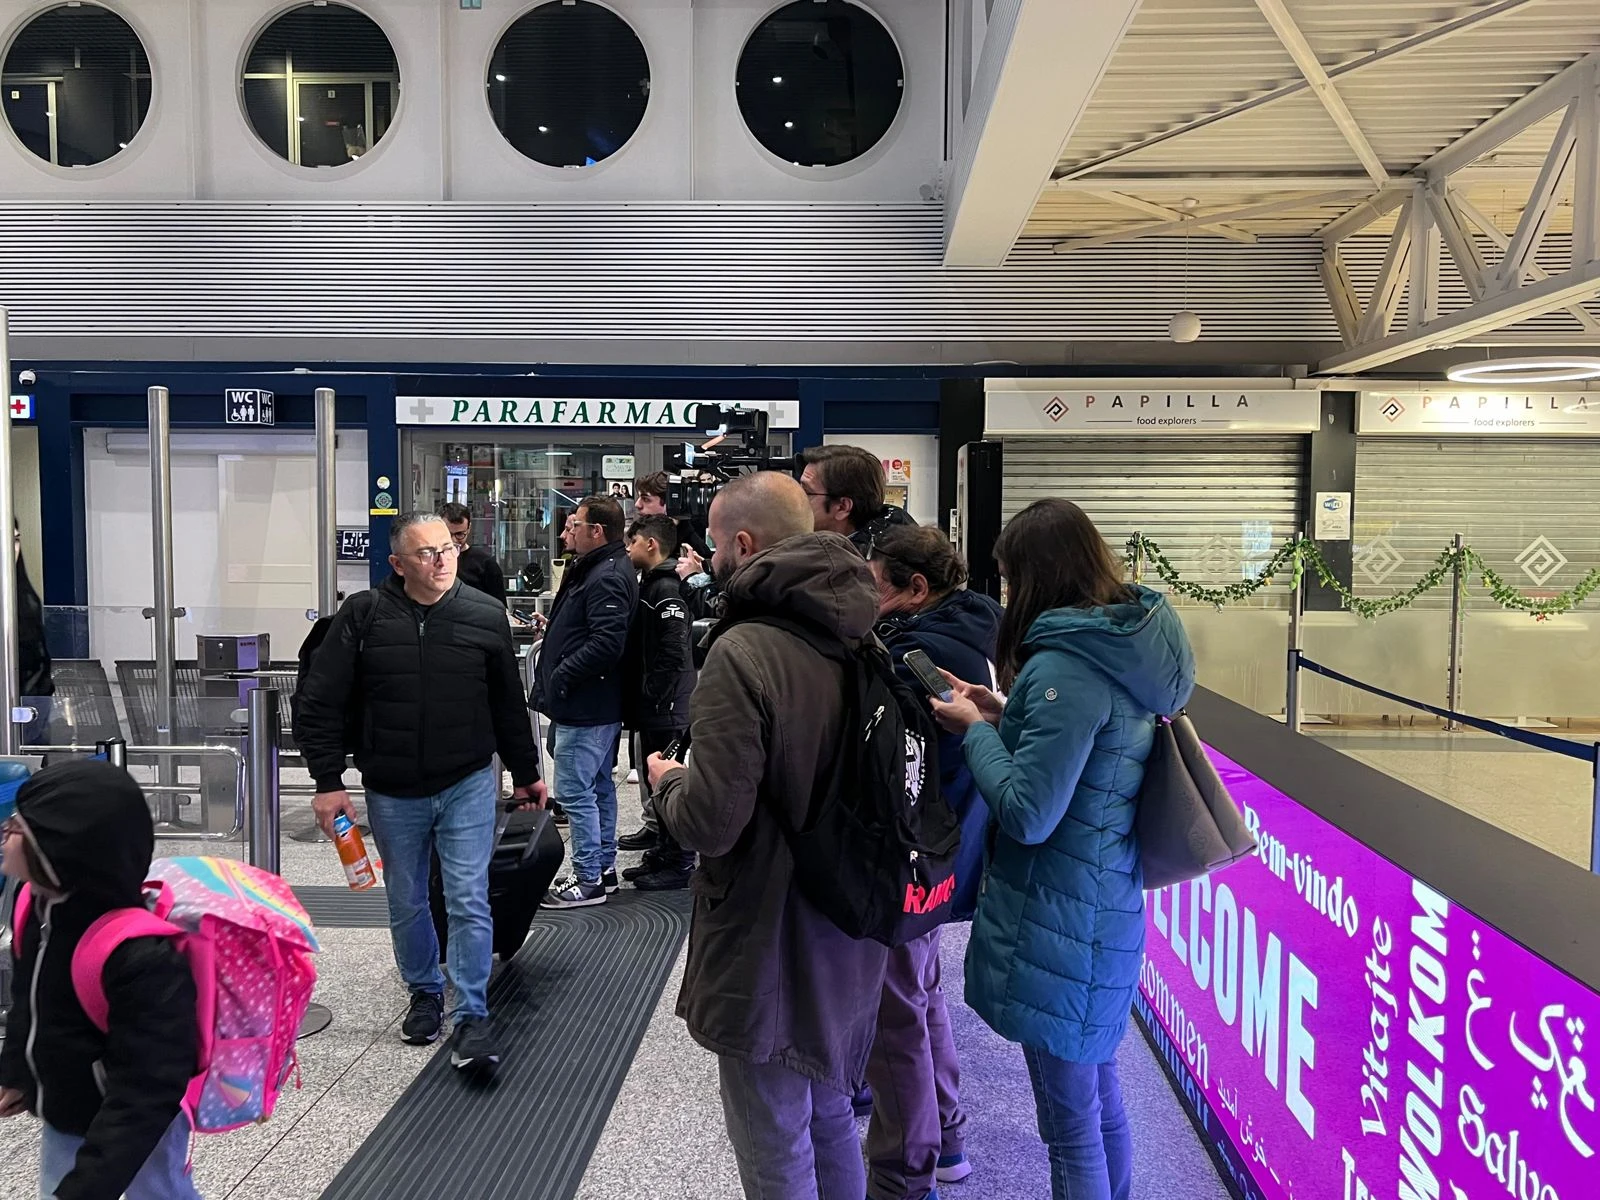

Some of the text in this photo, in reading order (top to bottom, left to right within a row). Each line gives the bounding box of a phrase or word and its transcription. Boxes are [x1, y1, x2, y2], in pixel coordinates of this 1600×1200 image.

[231, 391, 254, 403] WC
[261, 392, 272, 405] WC
[1085, 394, 1249, 408] PAPILLA
[450, 399, 741, 425] PARAFARMAC
[1136, 416, 1197, 426] food explorers
[1473, 418, 1535, 427] food explorers
[1243, 801, 1359, 938] Bem-vindo
[1142, 872, 1318, 1140] ELCOME
[1360, 915, 1399, 1137] Vitajte
[1398, 879, 1450, 1200] WOLKOM
